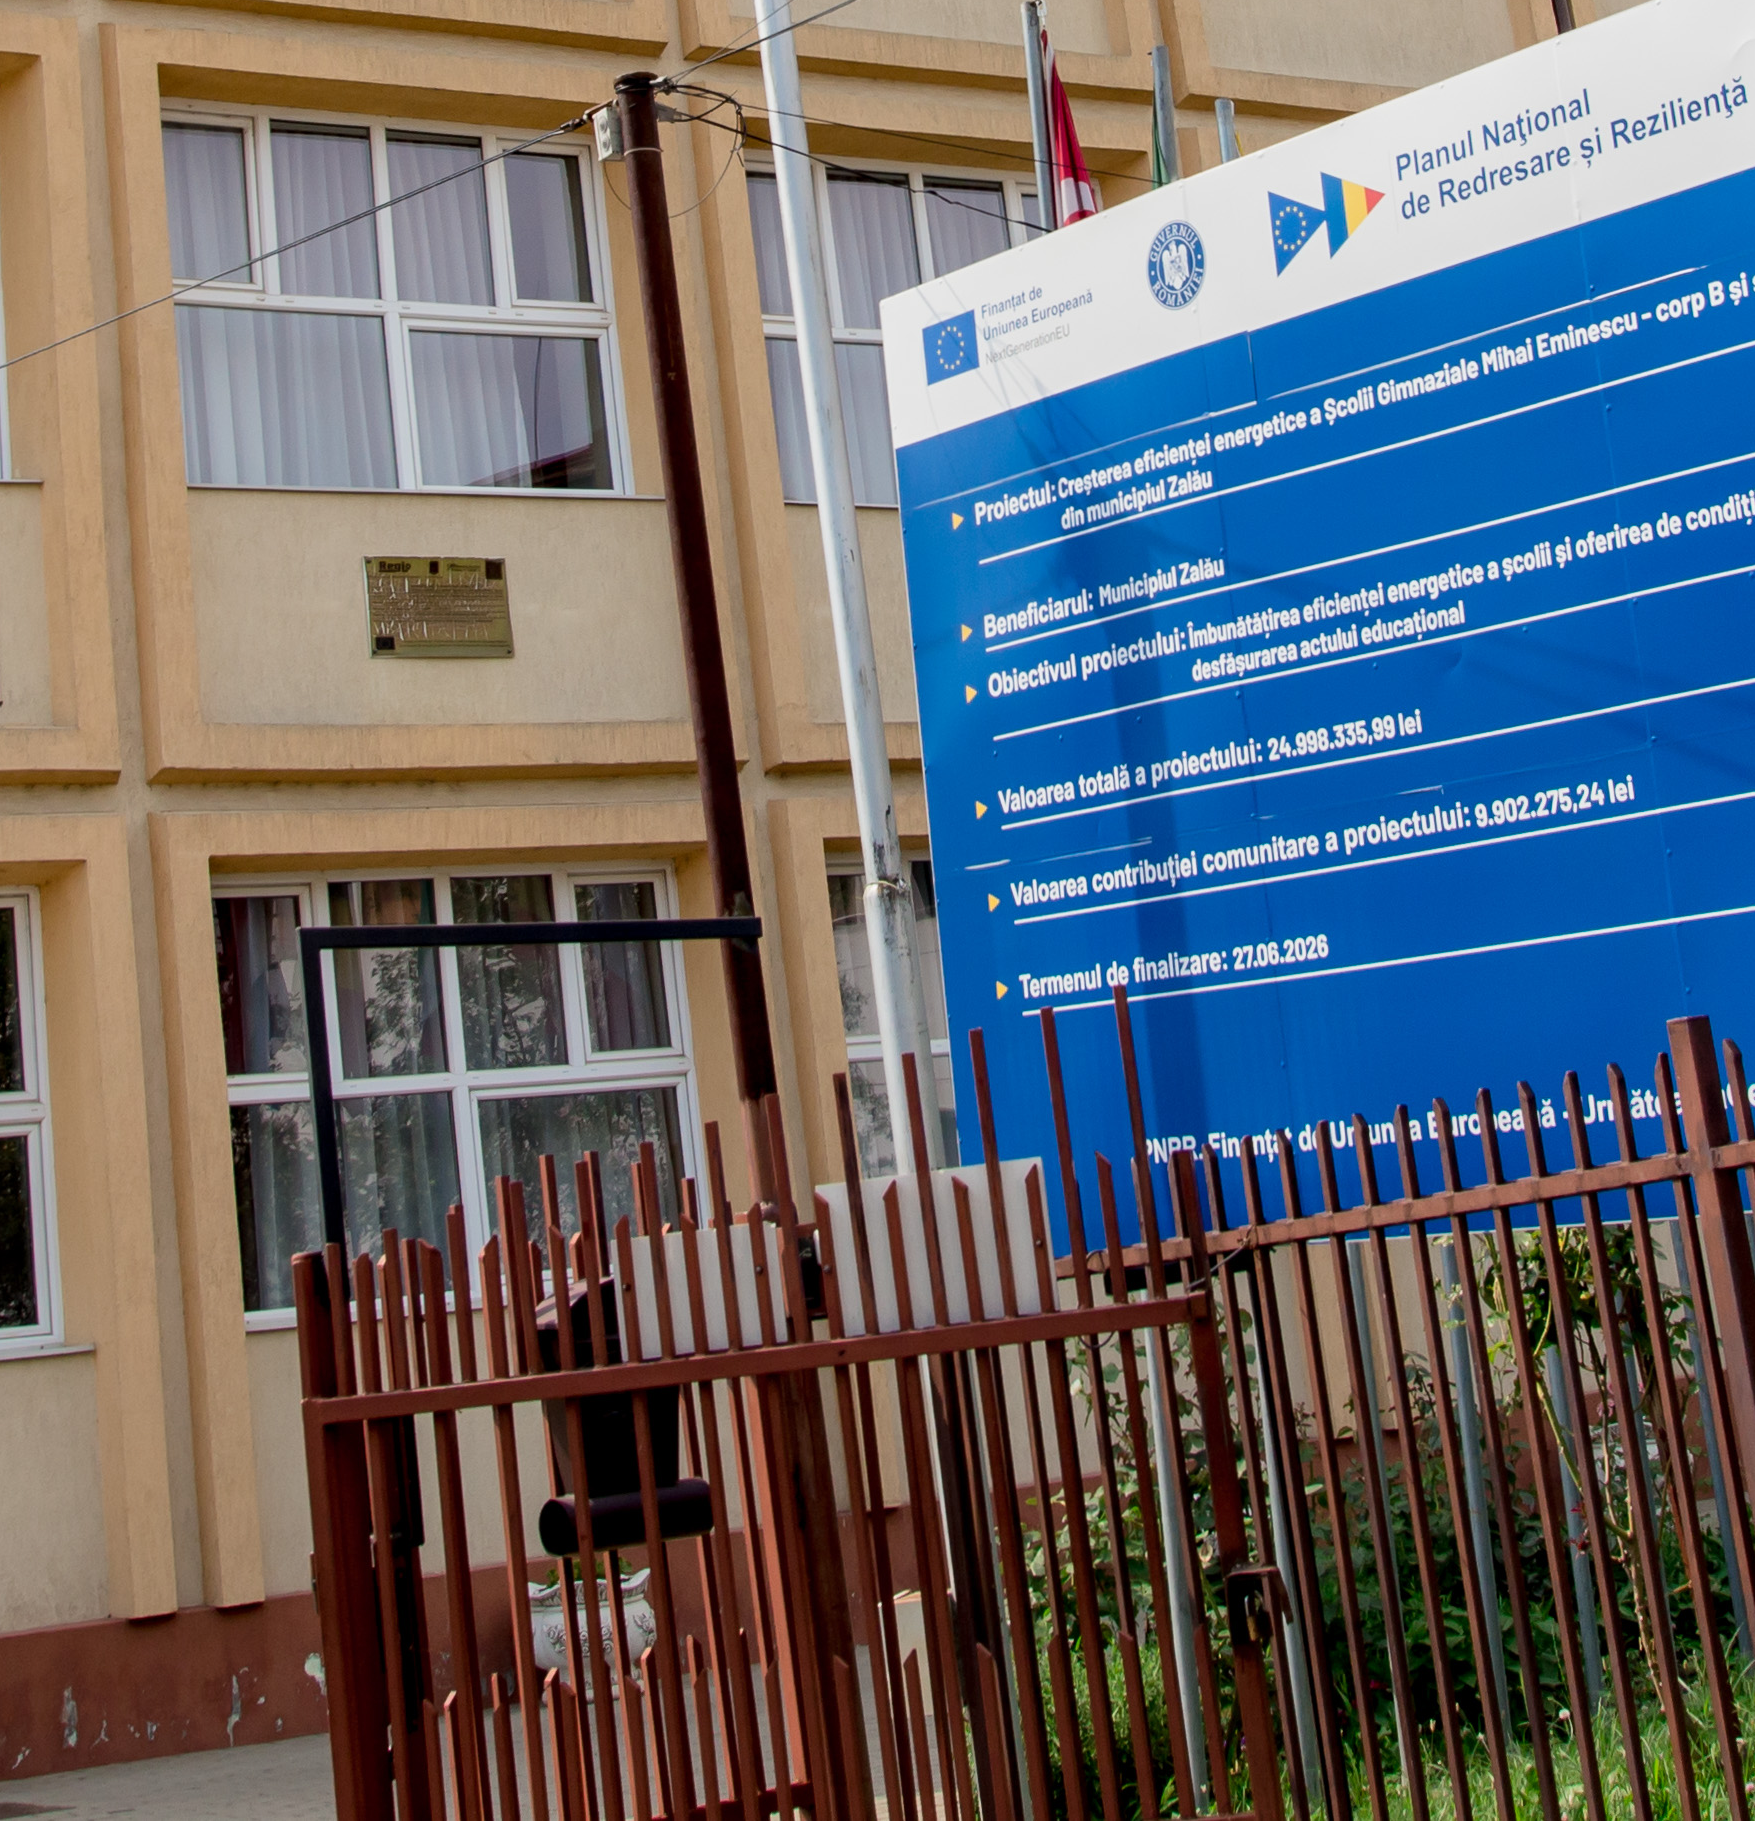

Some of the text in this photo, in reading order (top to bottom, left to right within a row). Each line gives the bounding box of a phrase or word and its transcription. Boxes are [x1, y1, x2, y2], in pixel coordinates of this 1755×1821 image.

[1396, 130, 1474, 180] Planul
[1401, 191, 1430, 219] de
[1439, 145, 1571, 207] Redresare
[1581, 127, 1603, 169] și
[1150, 224, 1198, 262] GUVERNUL
[981, 286, 1043, 319] Finanțat de
[983, 289, 1093, 341] Uniunea Europeană
[985, 323, 1071, 364] NextGenerationEU
[975, 481, 1056, 525] Proiectul:
[1058, 462, 1132, 498] Creșterea
[1134, 433, 1211, 474] eficienței
[1214, 412, 1306, 451] energetice
[1310, 408, 1321, 425] a
[1324, 386, 1374, 425] Școlii
[1378, 359, 1478, 405] Gimnaziale
[1482, 338, 1533, 374] Mihai
[1536, 312, 1638, 358] Eminescu
[1656, 292, 1705, 321] corp
[1709, 281, 1724, 306] B
[1729, 272, 1748, 305] și
[1062, 460, 1212, 529] din municipiul Zalău
[984, 558, 1224, 638] Beneficiarul: Municipiul Zalău
[988, 654, 1076, 697] Obiectivul
[1082, 628, 1186, 680] proiectului:
[1187, 608, 1300, 648] Îmbunătățirea
[1303, 582, 1384, 622] eficienței
[1388, 564, 1484, 603] energetice
[1488, 562, 1499, 580] a
[1502, 542, 1552, 581] școlii
[1555, 537, 1572, 568] și
[1576, 523, 1653, 558] oferirea
[1657, 513, 1682, 538] de
[1192, 601, 1465, 681] desfășurarea actului educațional
[998, 709, 1422, 813] Valoarea totală a proiectului: 24.998.335,99 lei
[1011, 775, 1634, 906] Valoarea contribuției comunitare a proiectului: 9.902.275,24 lei
[1019, 935, 1328, 998] Termenul de finalizare: 27.06.2026
